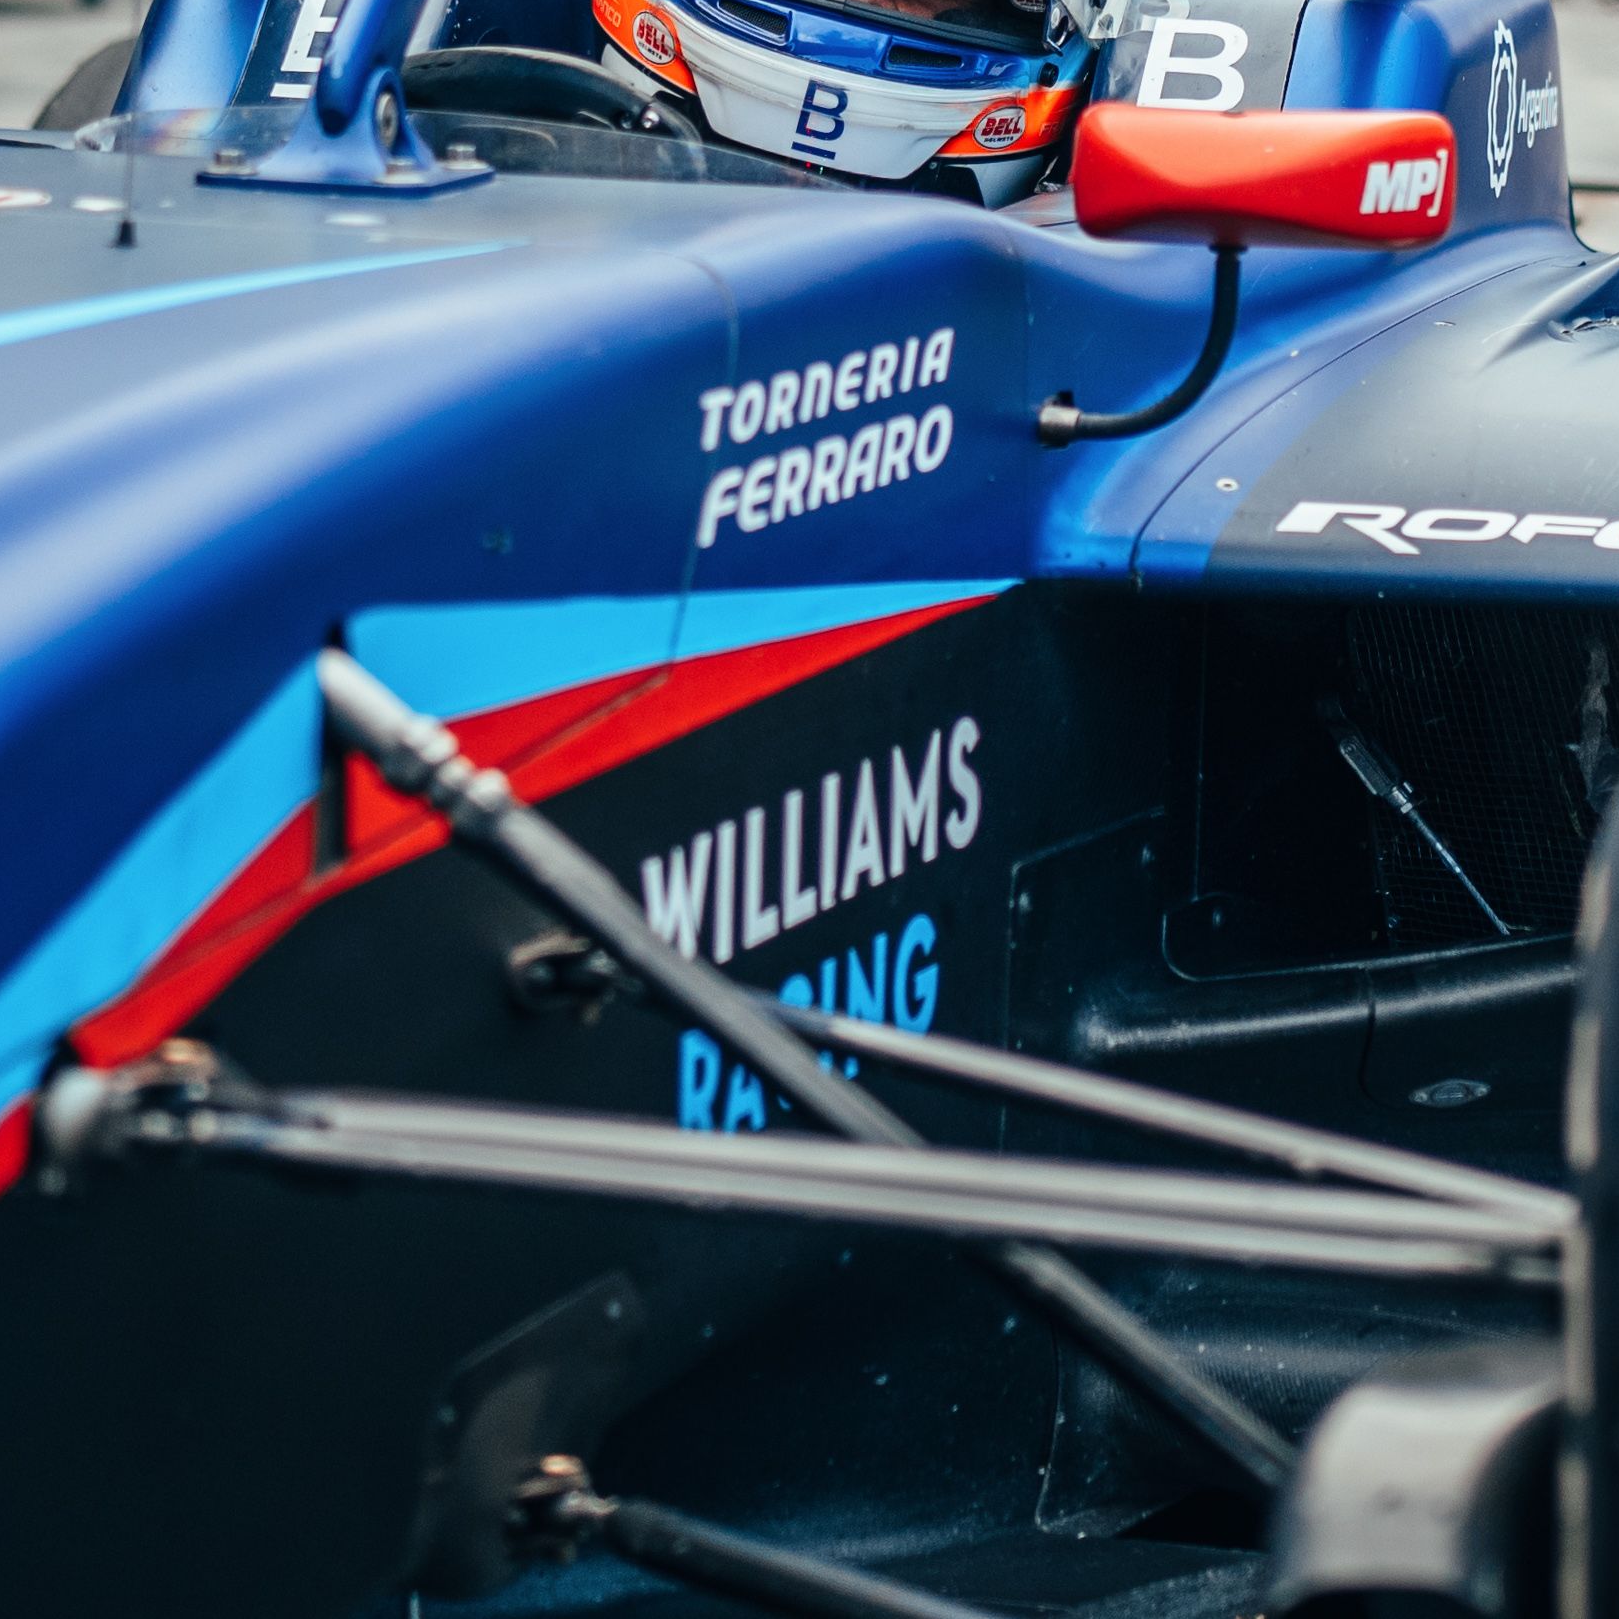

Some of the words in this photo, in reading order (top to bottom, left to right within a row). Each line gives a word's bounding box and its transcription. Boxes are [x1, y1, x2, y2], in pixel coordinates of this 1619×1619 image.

[637, 17, 671, 57] BELL
[1137, 18, 1248, 111] B
[795, 79, 848, 142] B
[980, 115, 1023, 137] BELL
[1517, 70, 1559, 149] Argentina
[700, 326, 956, 453] TORNERIA
[696, 404, 954, 549] FERRARO
[640, 715, 983, 966] WILLIAMS
